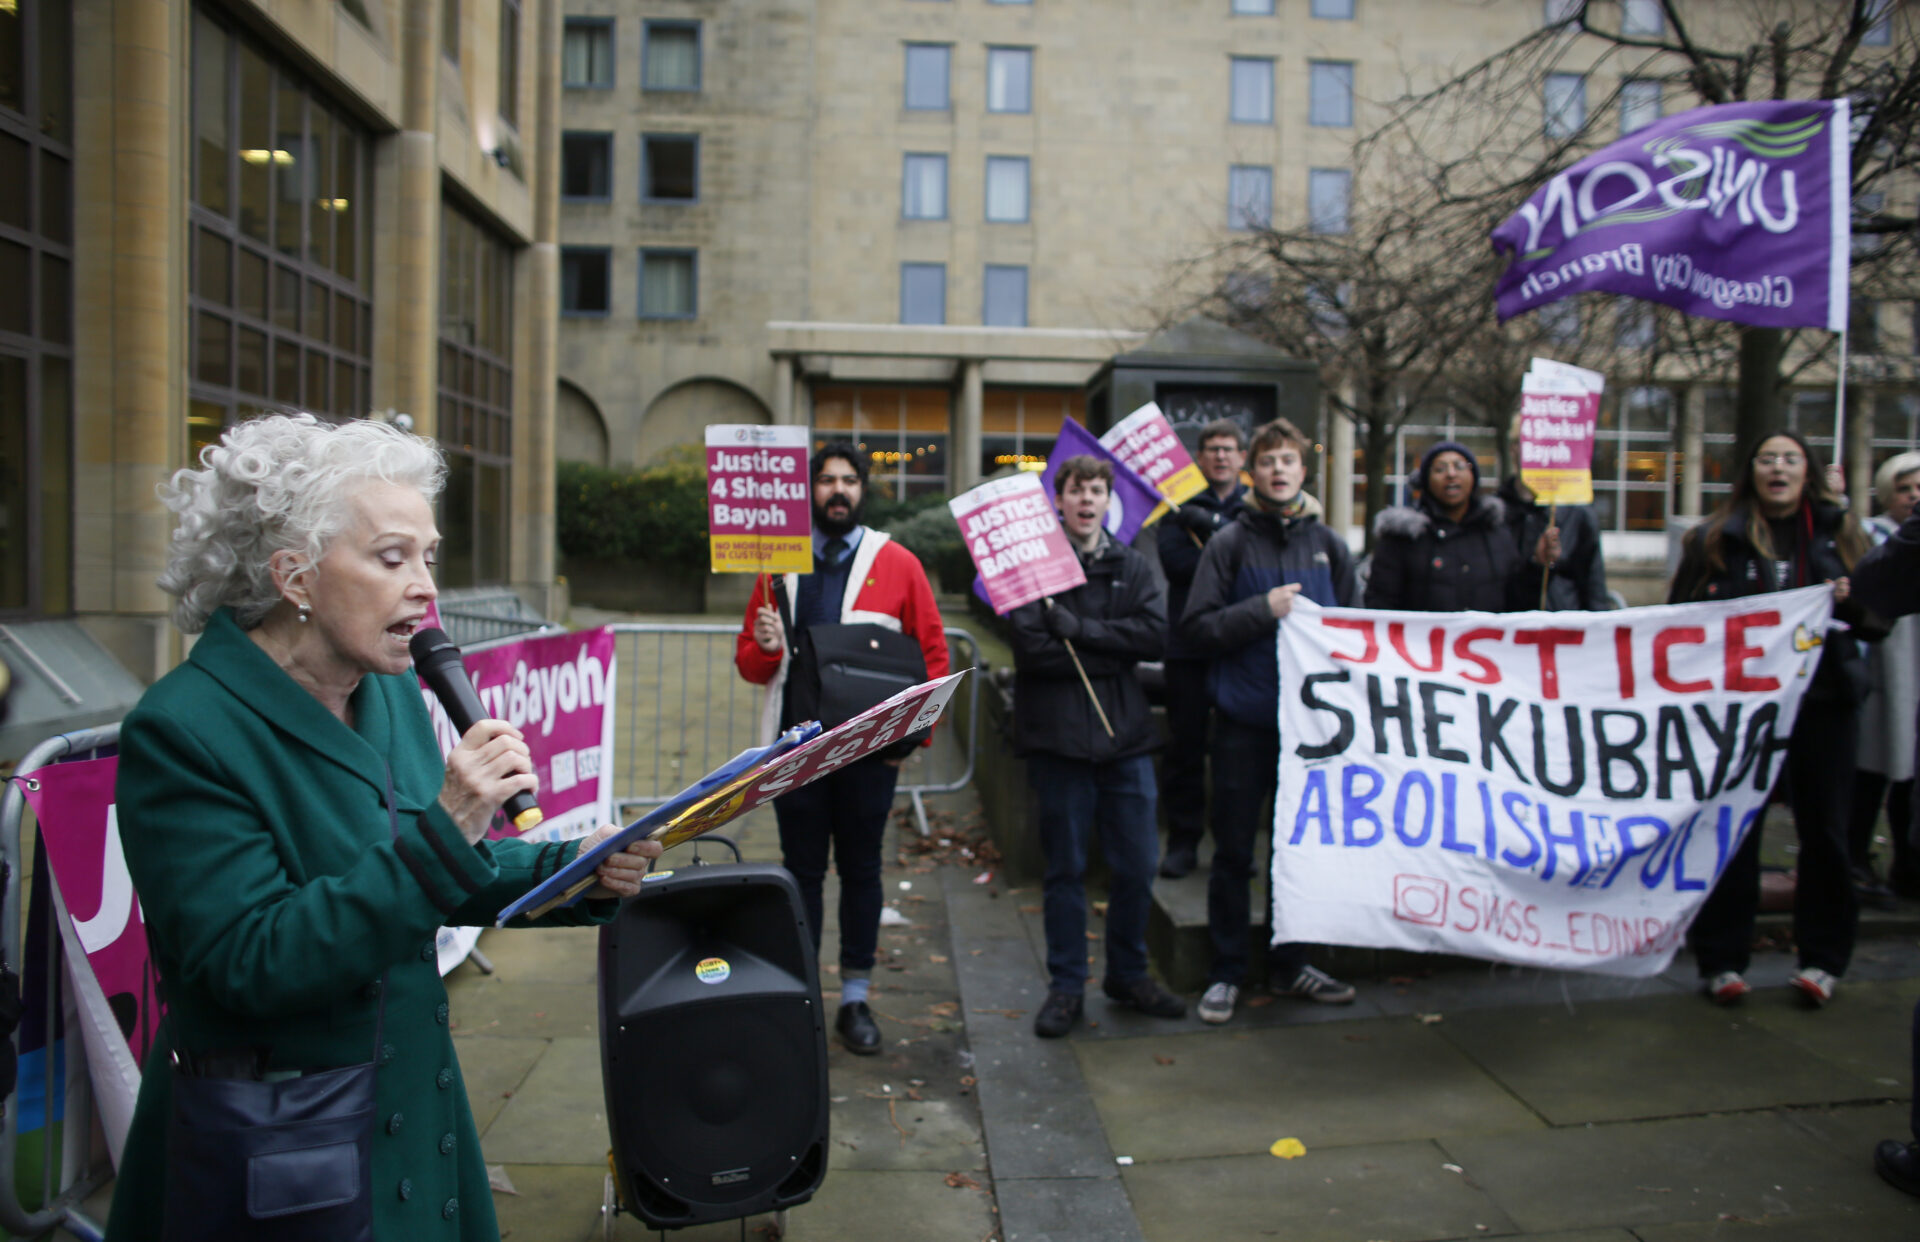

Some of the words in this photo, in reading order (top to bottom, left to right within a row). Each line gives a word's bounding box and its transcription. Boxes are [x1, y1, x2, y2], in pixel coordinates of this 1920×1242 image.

[1521, 395, 1580, 417] Justice
[1533, 417, 1586, 441] Sheku
[710, 450, 797, 474] Justice
[1522, 441, 1572, 467] Bayoh
[711, 478, 728, 499] 4
[731, 476, 807, 500] Sheku
[713, 503, 788, 531] Bayoh
[967, 493, 1050, 540] JUSTICE
[973, 536, 991, 558] 4
[987, 511, 1058, 552] SHEKU
[979, 537, 1051, 580] BAYOH
[1321, 610, 1782, 700] JUSTICE
[1288, 764, 1592, 889] ABOLISH
